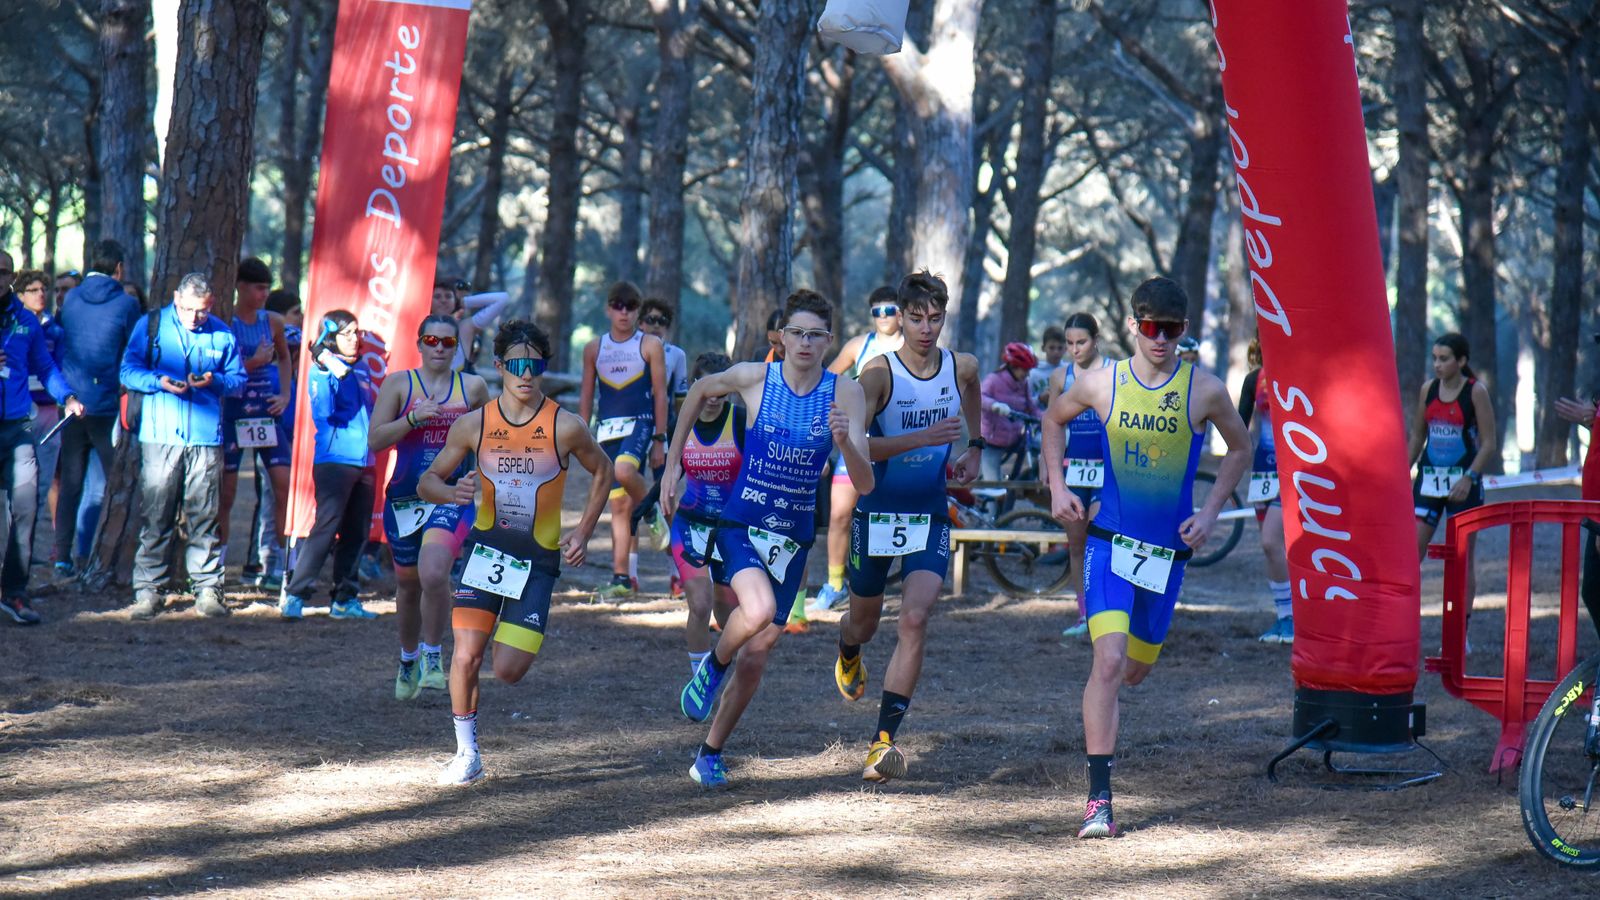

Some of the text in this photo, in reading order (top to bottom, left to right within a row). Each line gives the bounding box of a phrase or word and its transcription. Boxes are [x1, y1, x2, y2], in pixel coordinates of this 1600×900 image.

[365, 24, 421, 229] Deporte
[901, 407, 949, 430] VALENTIN
[1118, 411, 1178, 434] RAMOS
[246, 426, 268, 441] 18
[423, 430, 447, 444] RUIZ
[687, 459, 731, 467] CHICLANA
[767, 441, 816, 466] SUAREZ
[497, 457, 535, 475] ESPEJO
[1078, 469, 1098, 482] 10
[1261, 480, 1271, 495] 8
[1433, 476, 1451, 492] 11
[414, 508, 426, 527] 2
[892, 526, 908, 548] 5
[767, 545, 780, 566] 6
[1132, 553, 1148, 576] 7
[487, 563, 505, 585] 3
